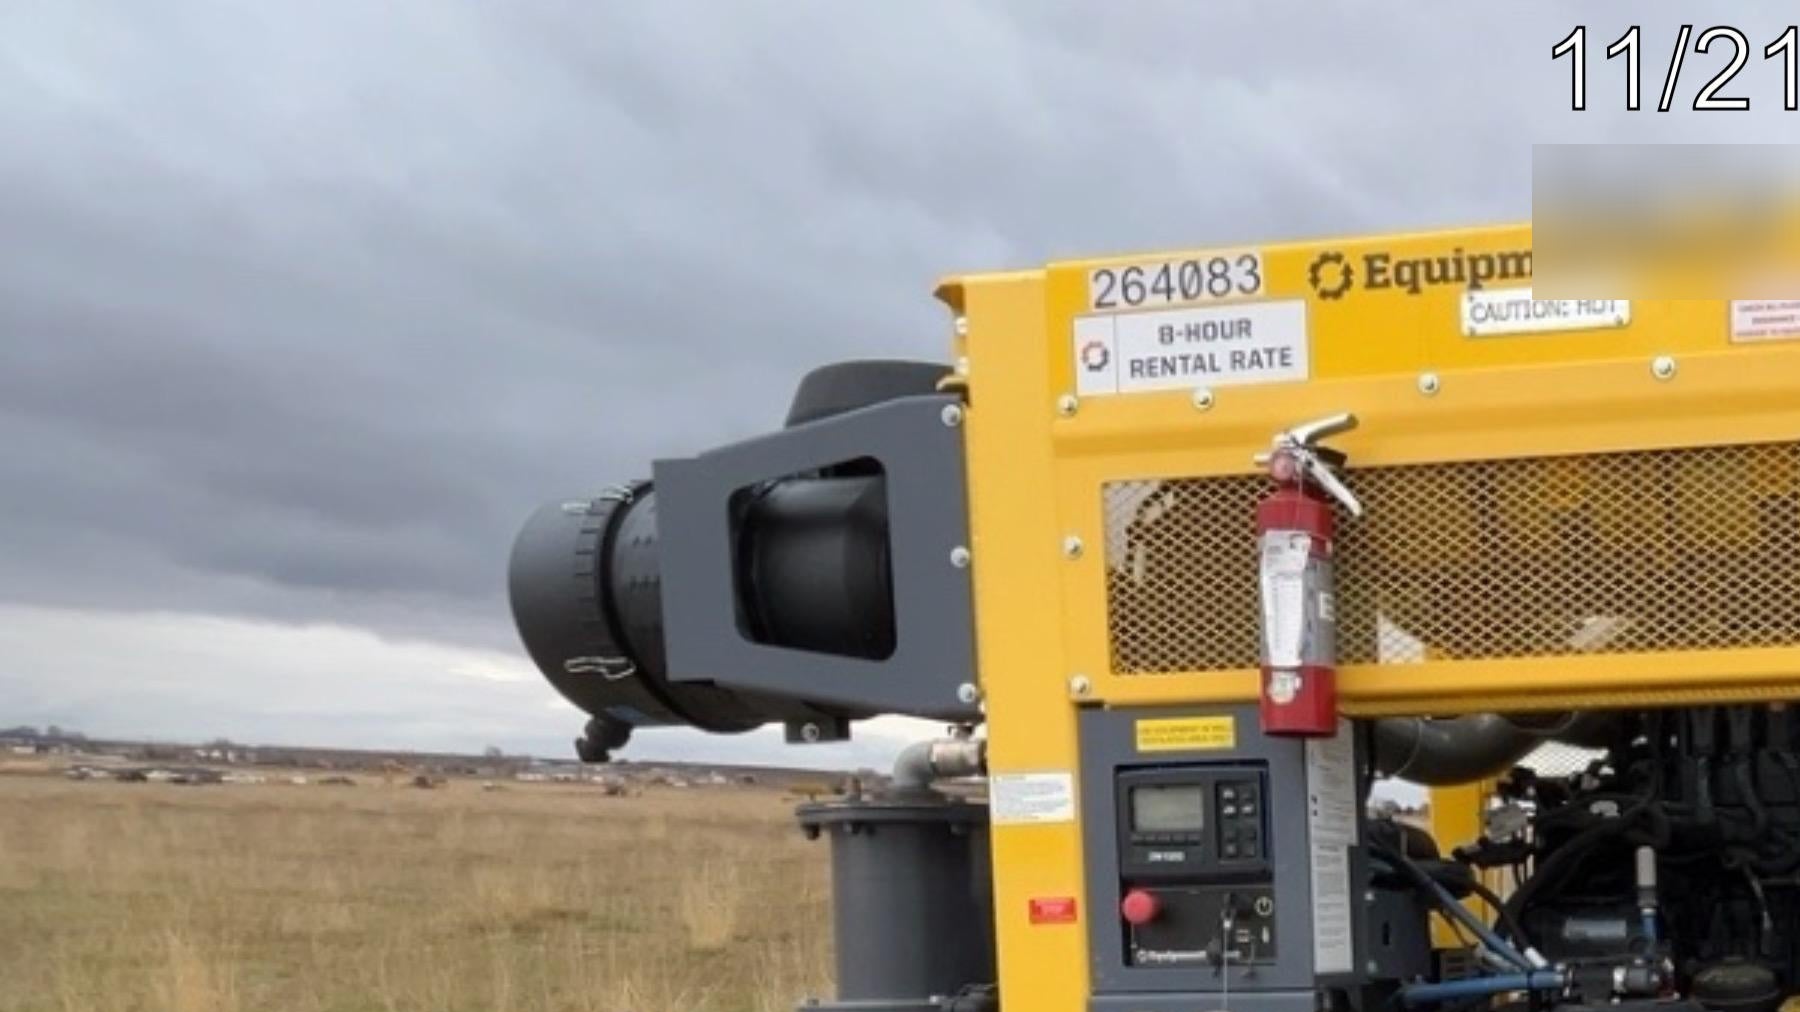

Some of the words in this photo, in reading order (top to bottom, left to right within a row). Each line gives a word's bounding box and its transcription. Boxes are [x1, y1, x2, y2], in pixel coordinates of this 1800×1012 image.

[1093, 254, 1261, 309] 264083
[1470, 298, 1570, 323] CAUTION:
[1158, 317, 1253, 345] 8-HOUR
[1130, 352, 1221, 378] RENTAL
[1229, 346, 1293, 371] RATE
